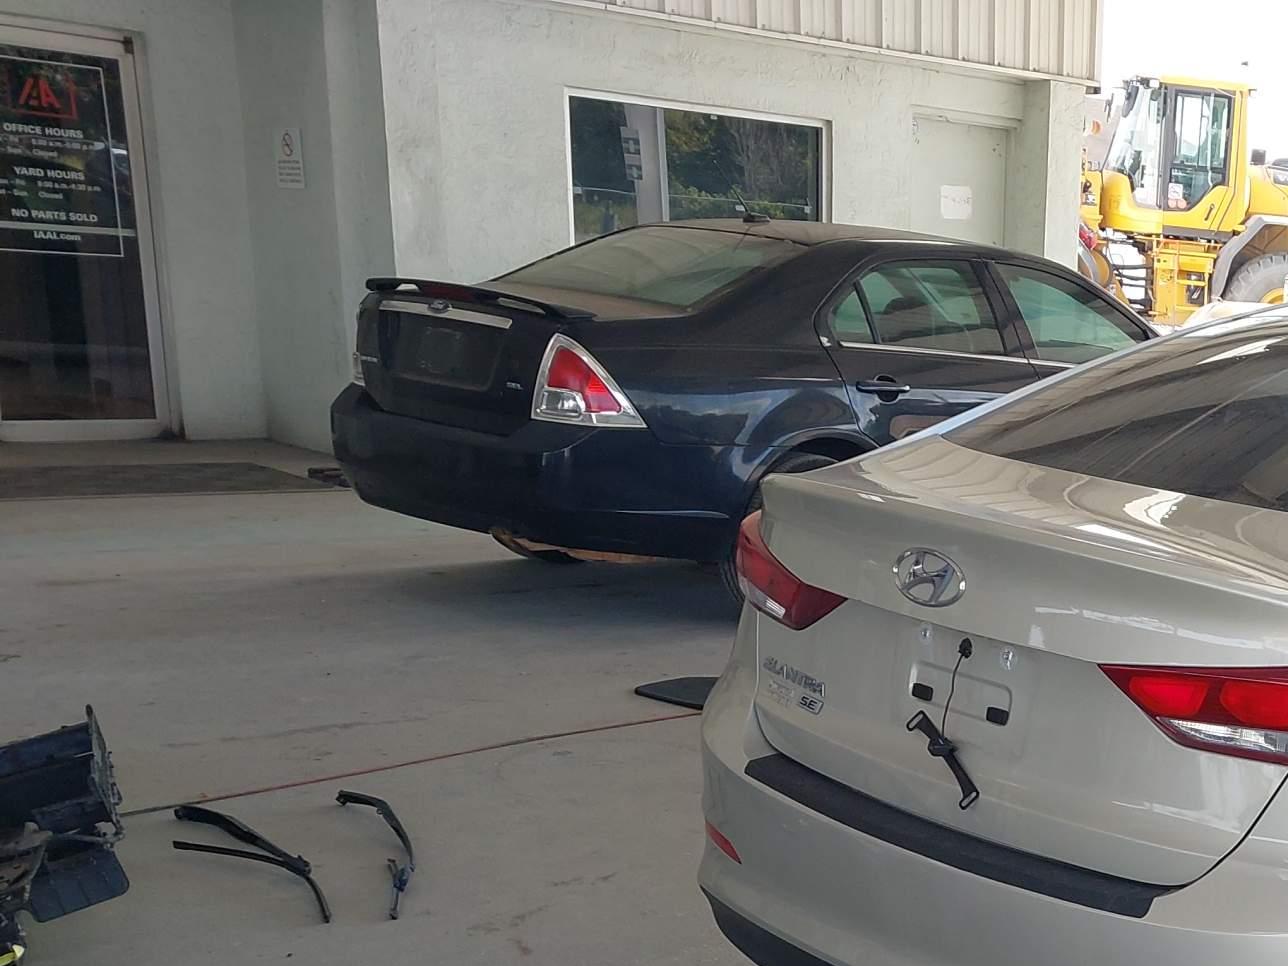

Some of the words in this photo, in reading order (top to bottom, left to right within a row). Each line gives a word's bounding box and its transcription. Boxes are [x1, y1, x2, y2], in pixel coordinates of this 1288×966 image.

[3, 122, 42, 135] OFFICE
[45, 127, 83, 139] HOURS
[13, 166, 44, 177] YARD
[47, 169, 85, 181] HOURS
[11, 208, 29, 218] NO
[31, 209, 66, 221] PARTS
[68, 212, 98, 222] SOLD
[800, 695, 818, 711] SE
